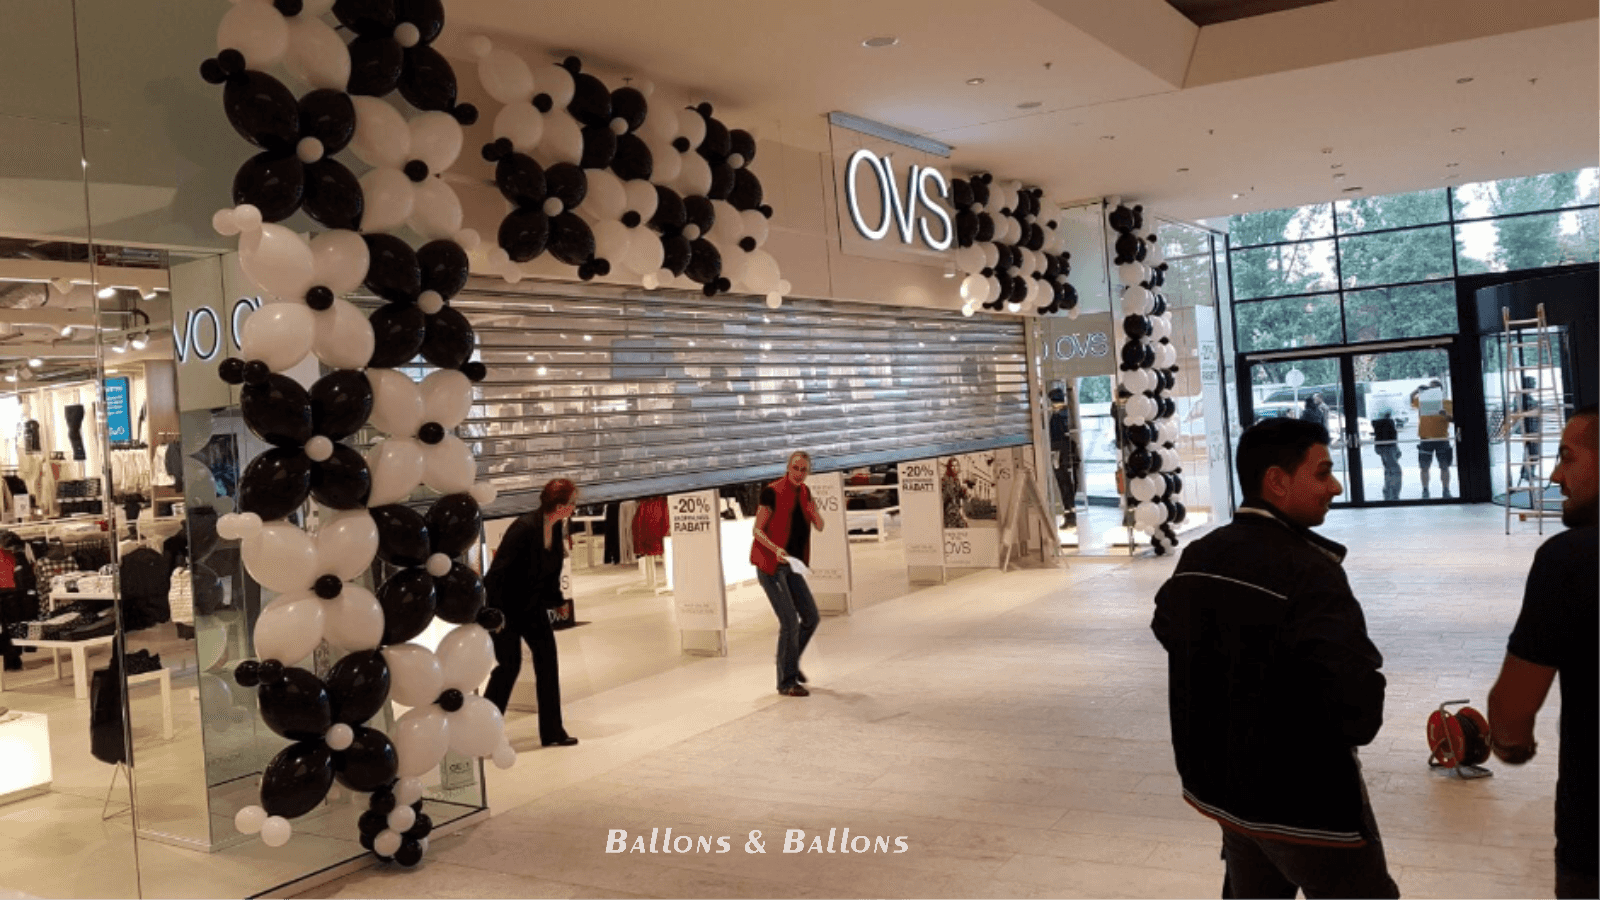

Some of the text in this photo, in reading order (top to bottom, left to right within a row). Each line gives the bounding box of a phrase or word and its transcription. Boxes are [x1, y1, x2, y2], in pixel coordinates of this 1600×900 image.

[845, 149, 953, 251] OVS
[1055, 333, 1109, 360] OVS
[901, 465, 934, 477] -20%
[902, 483, 934, 491] RABATT
[673, 498, 711, 513] -20%
[674, 521, 711, 532] RABATT
[944, 541, 972, 554] OVS
